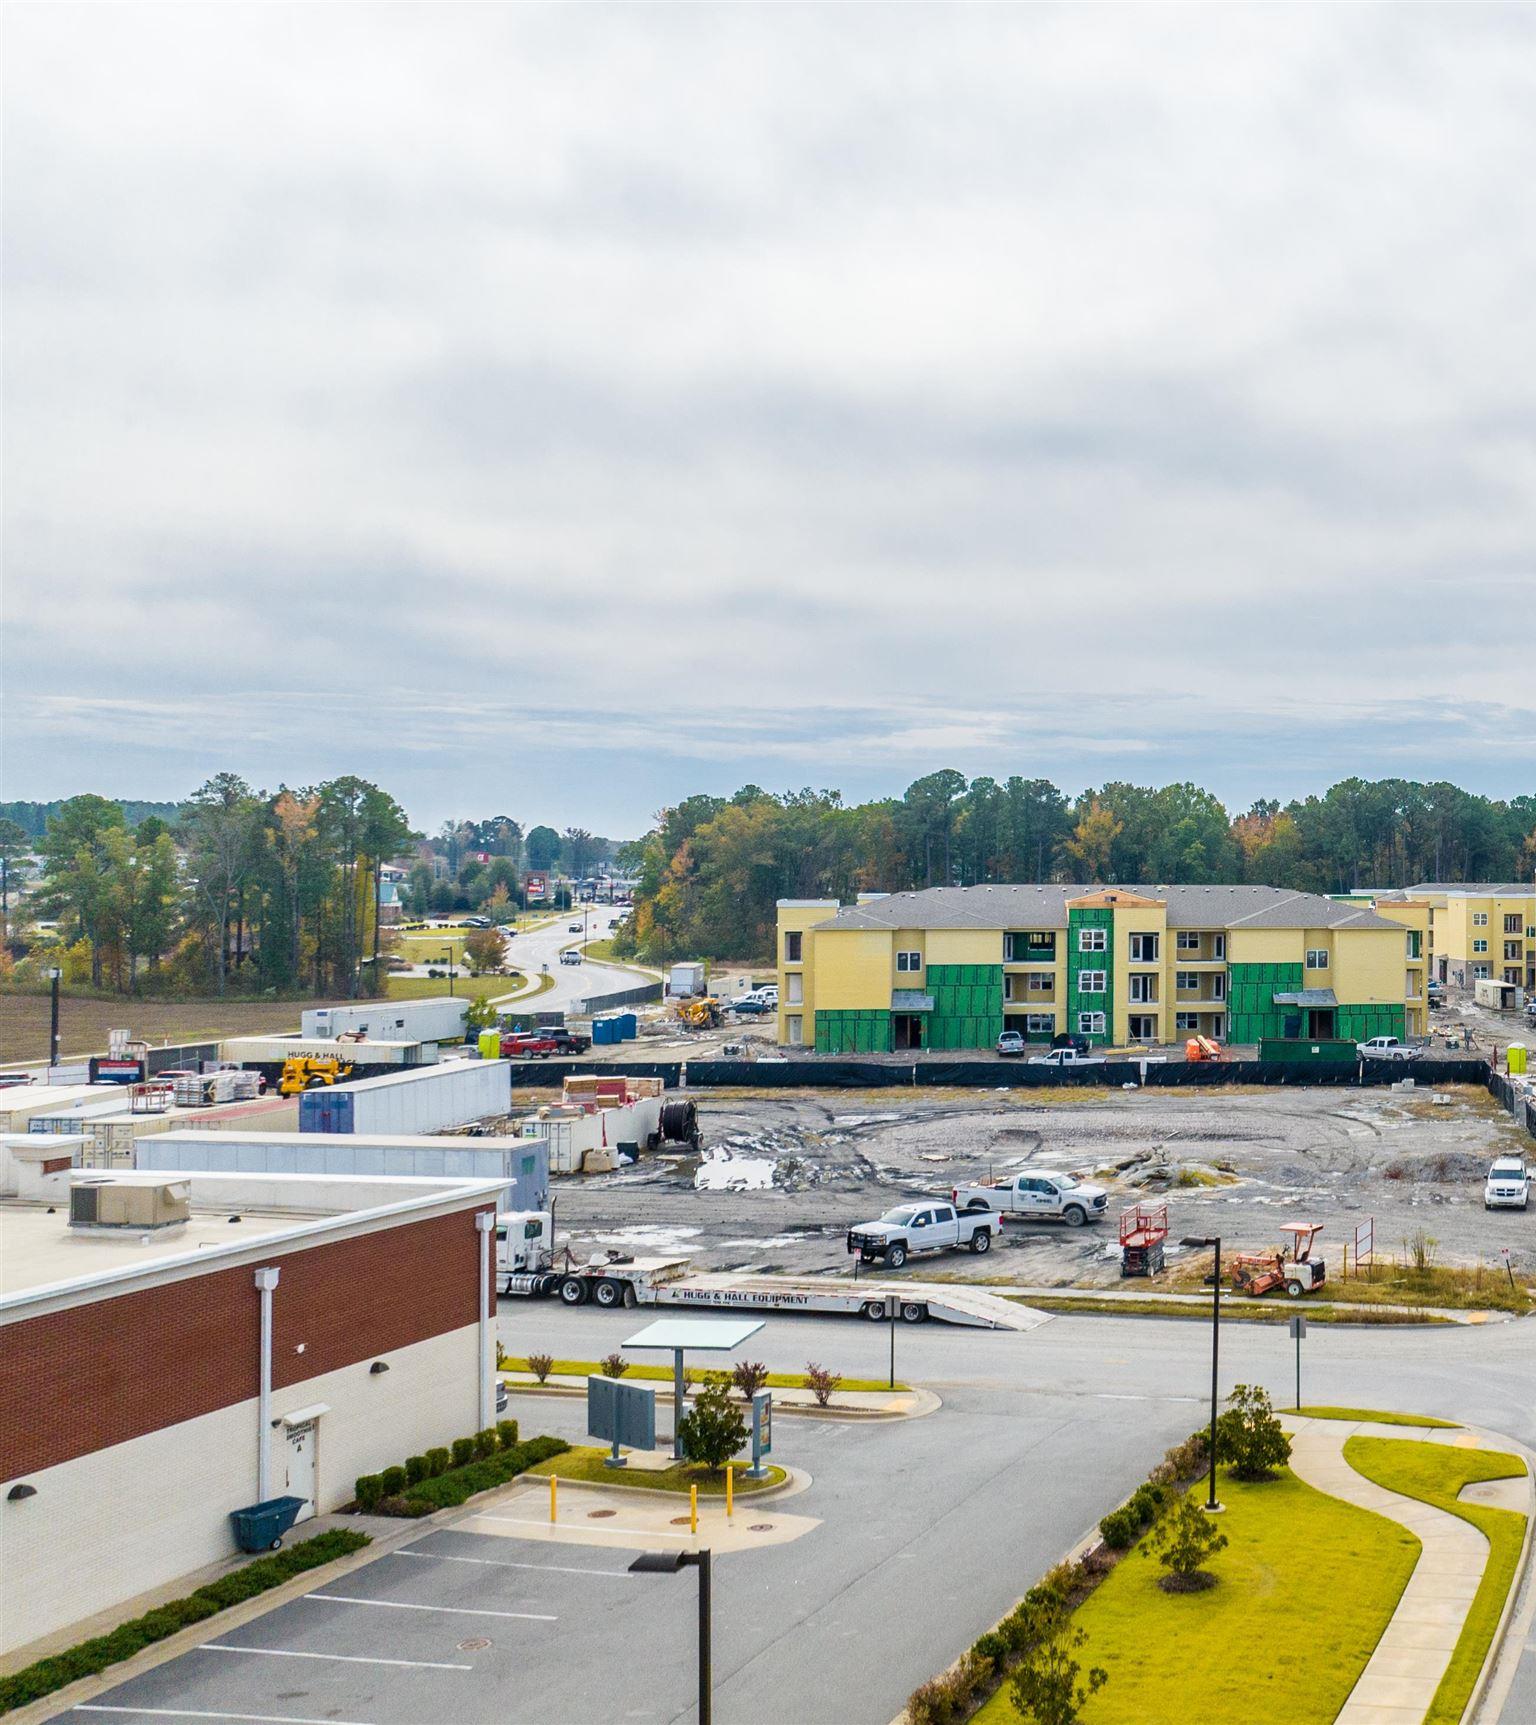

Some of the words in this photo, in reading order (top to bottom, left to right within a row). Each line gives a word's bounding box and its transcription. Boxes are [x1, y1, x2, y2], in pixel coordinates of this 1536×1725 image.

[288, 1051, 313, 1059] HUGG
[683, 1291, 711, 1300] HUGG
[724, 1293, 750, 1302] HALL
[752, 1294, 809, 1304] EQUIPMENT
